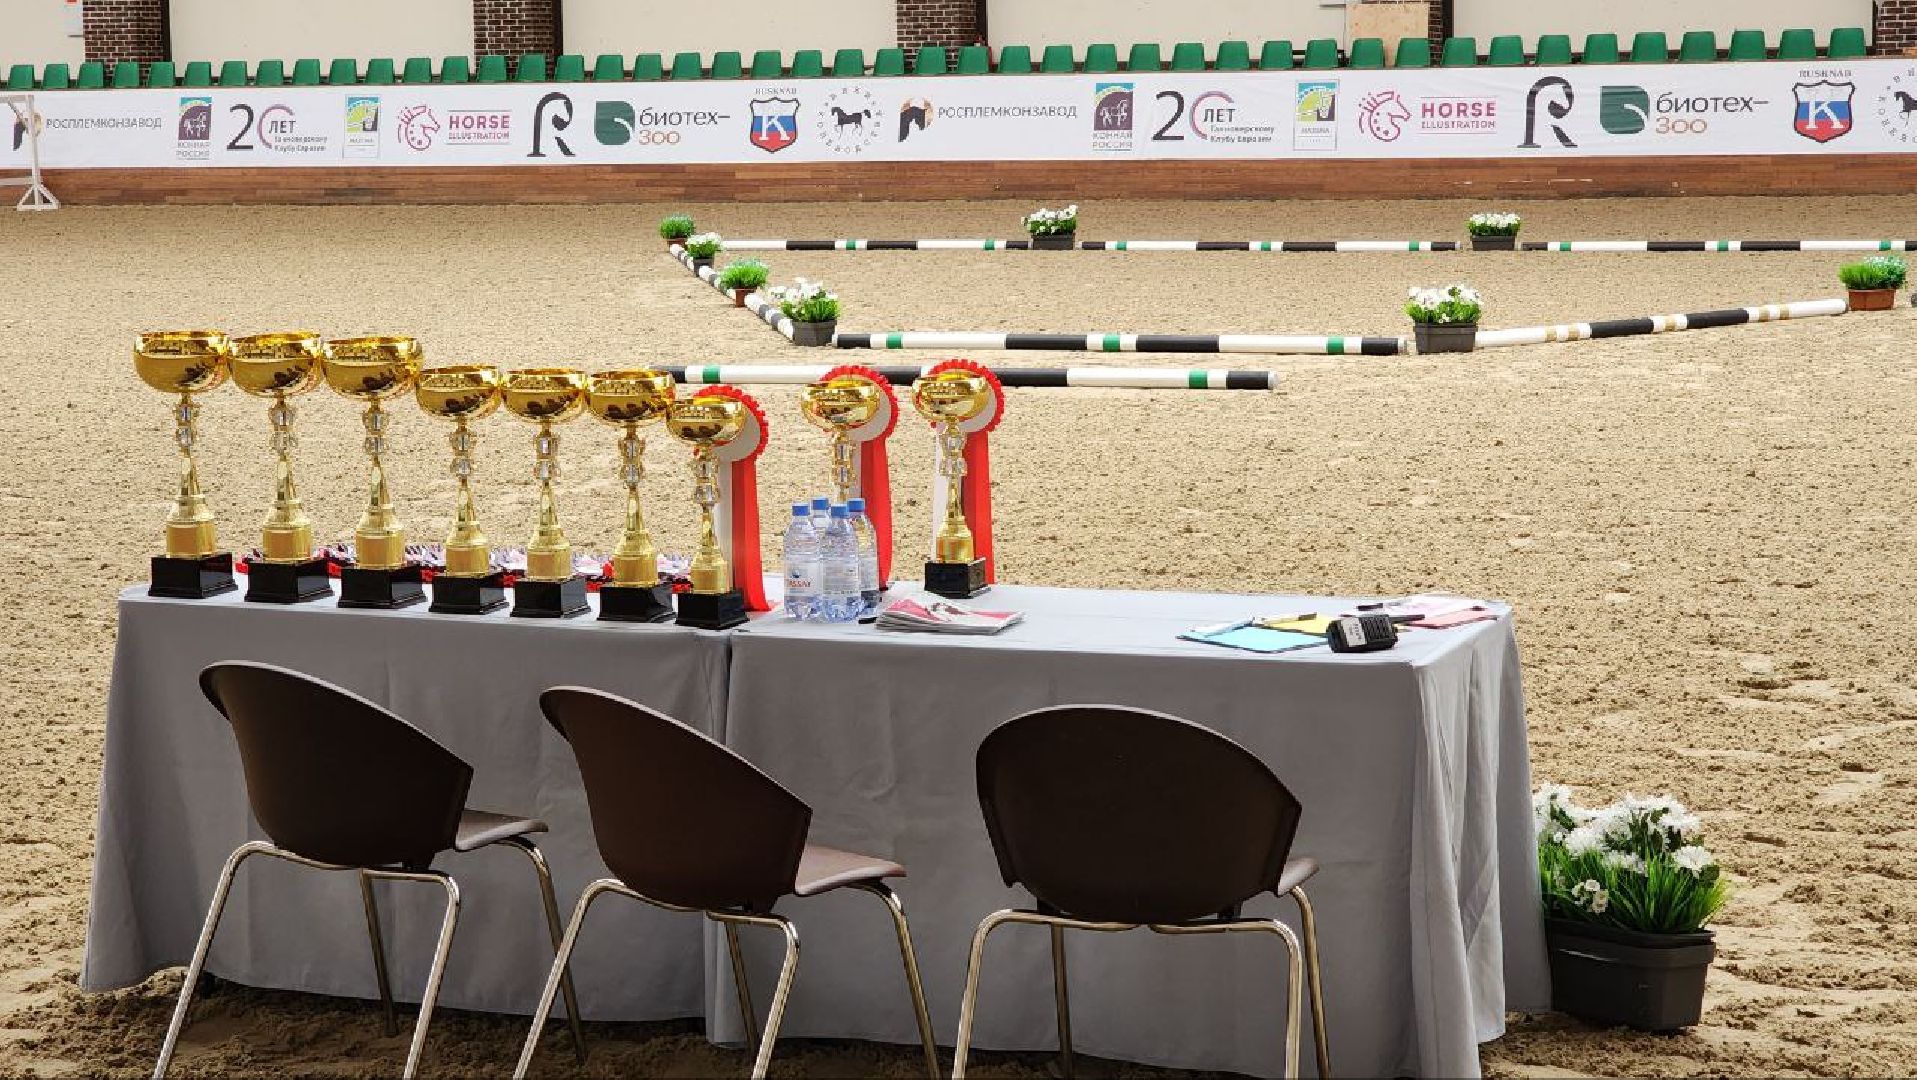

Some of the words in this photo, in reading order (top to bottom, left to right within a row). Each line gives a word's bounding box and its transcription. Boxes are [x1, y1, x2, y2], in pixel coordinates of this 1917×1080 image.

[938, 105, 1078, 119] РОСПЛЕМКОНЗАВОД
[1203, 108, 1236, 123] ЛЕТ
[1421, 102, 1496, 118] HORSE
[45, 117, 162, 129] РОСПЛЕМКОНЗАВОД
[268, 120, 296, 134] ЛЕТ
[449, 115, 510, 129] HORSE
[1421, 121, 1496, 129] ILLUSTRATION
[448, 131, 510, 140] ILLUSTRATION
